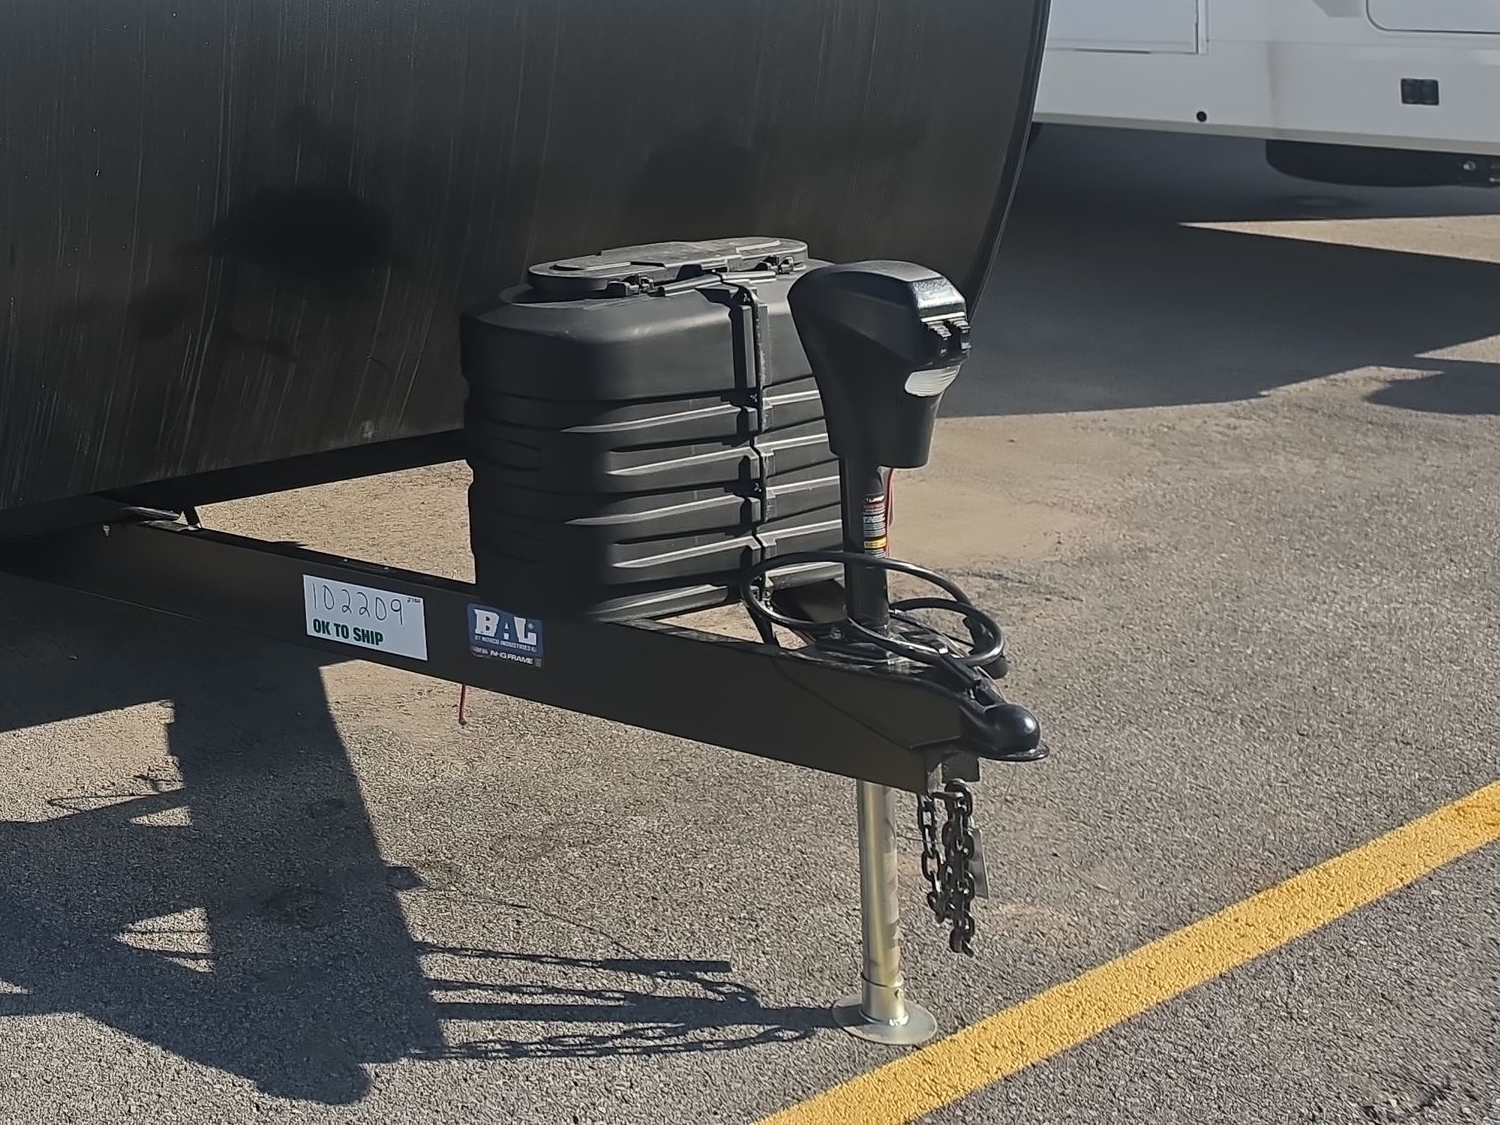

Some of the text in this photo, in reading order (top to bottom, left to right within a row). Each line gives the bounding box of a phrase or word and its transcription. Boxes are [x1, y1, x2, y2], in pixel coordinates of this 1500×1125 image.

[313, 582, 403, 626] 102209
[313, 618, 384, 646] OK TO SHIP
[474, 608, 537, 646] BAL
